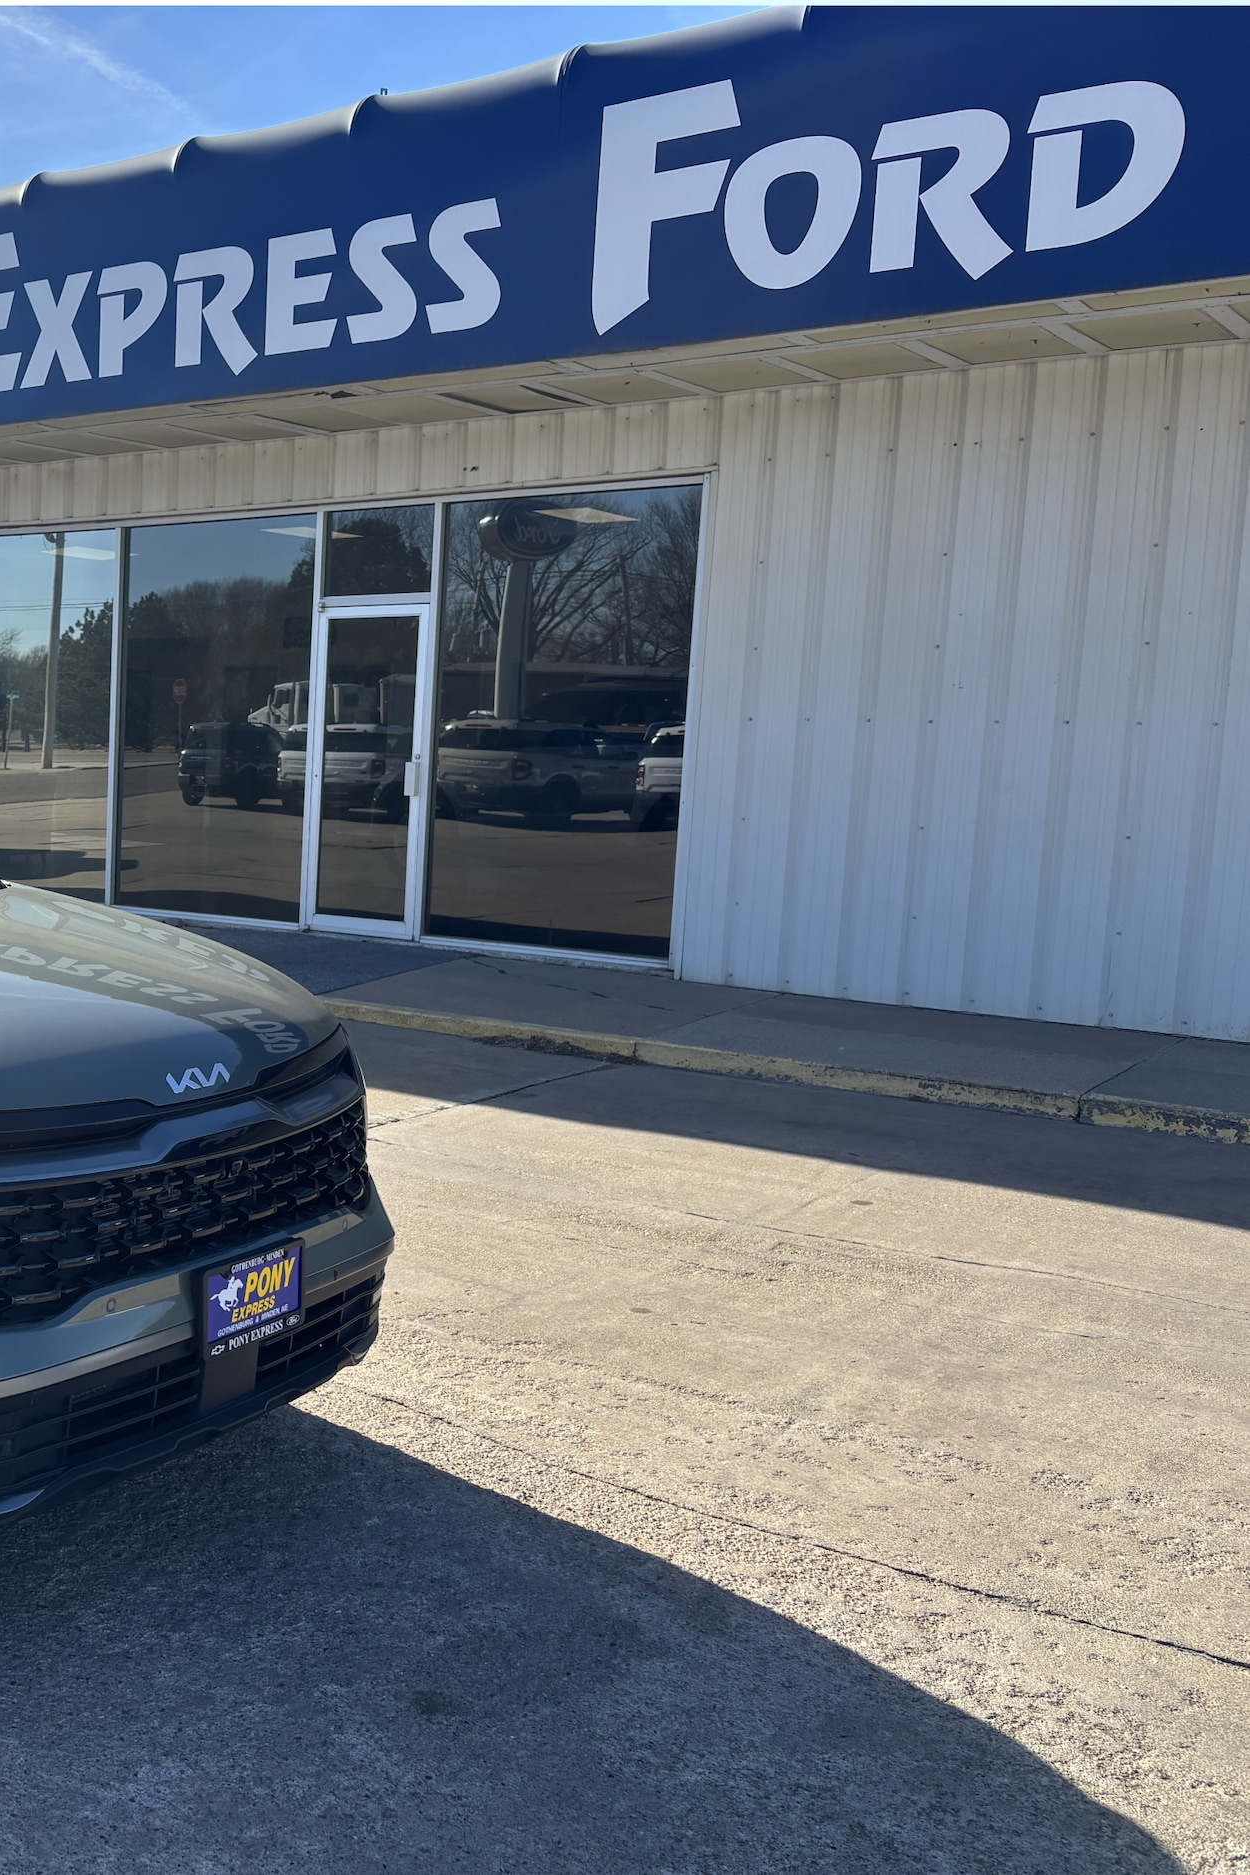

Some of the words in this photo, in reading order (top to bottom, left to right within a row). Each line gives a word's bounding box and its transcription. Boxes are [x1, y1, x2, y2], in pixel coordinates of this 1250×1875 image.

[591, 78, 1186, 337] FORD
[165, 1062, 230, 1094] KIA
[244, 1256, 296, 1303] PONY
[231, 1295, 276, 1323] EXPRESS
[217, 1317, 254, 1337] GOTHENBURG
[228, 1332, 251, 1351] PONY
[251, 1319, 284, 1341] EXPRESS
